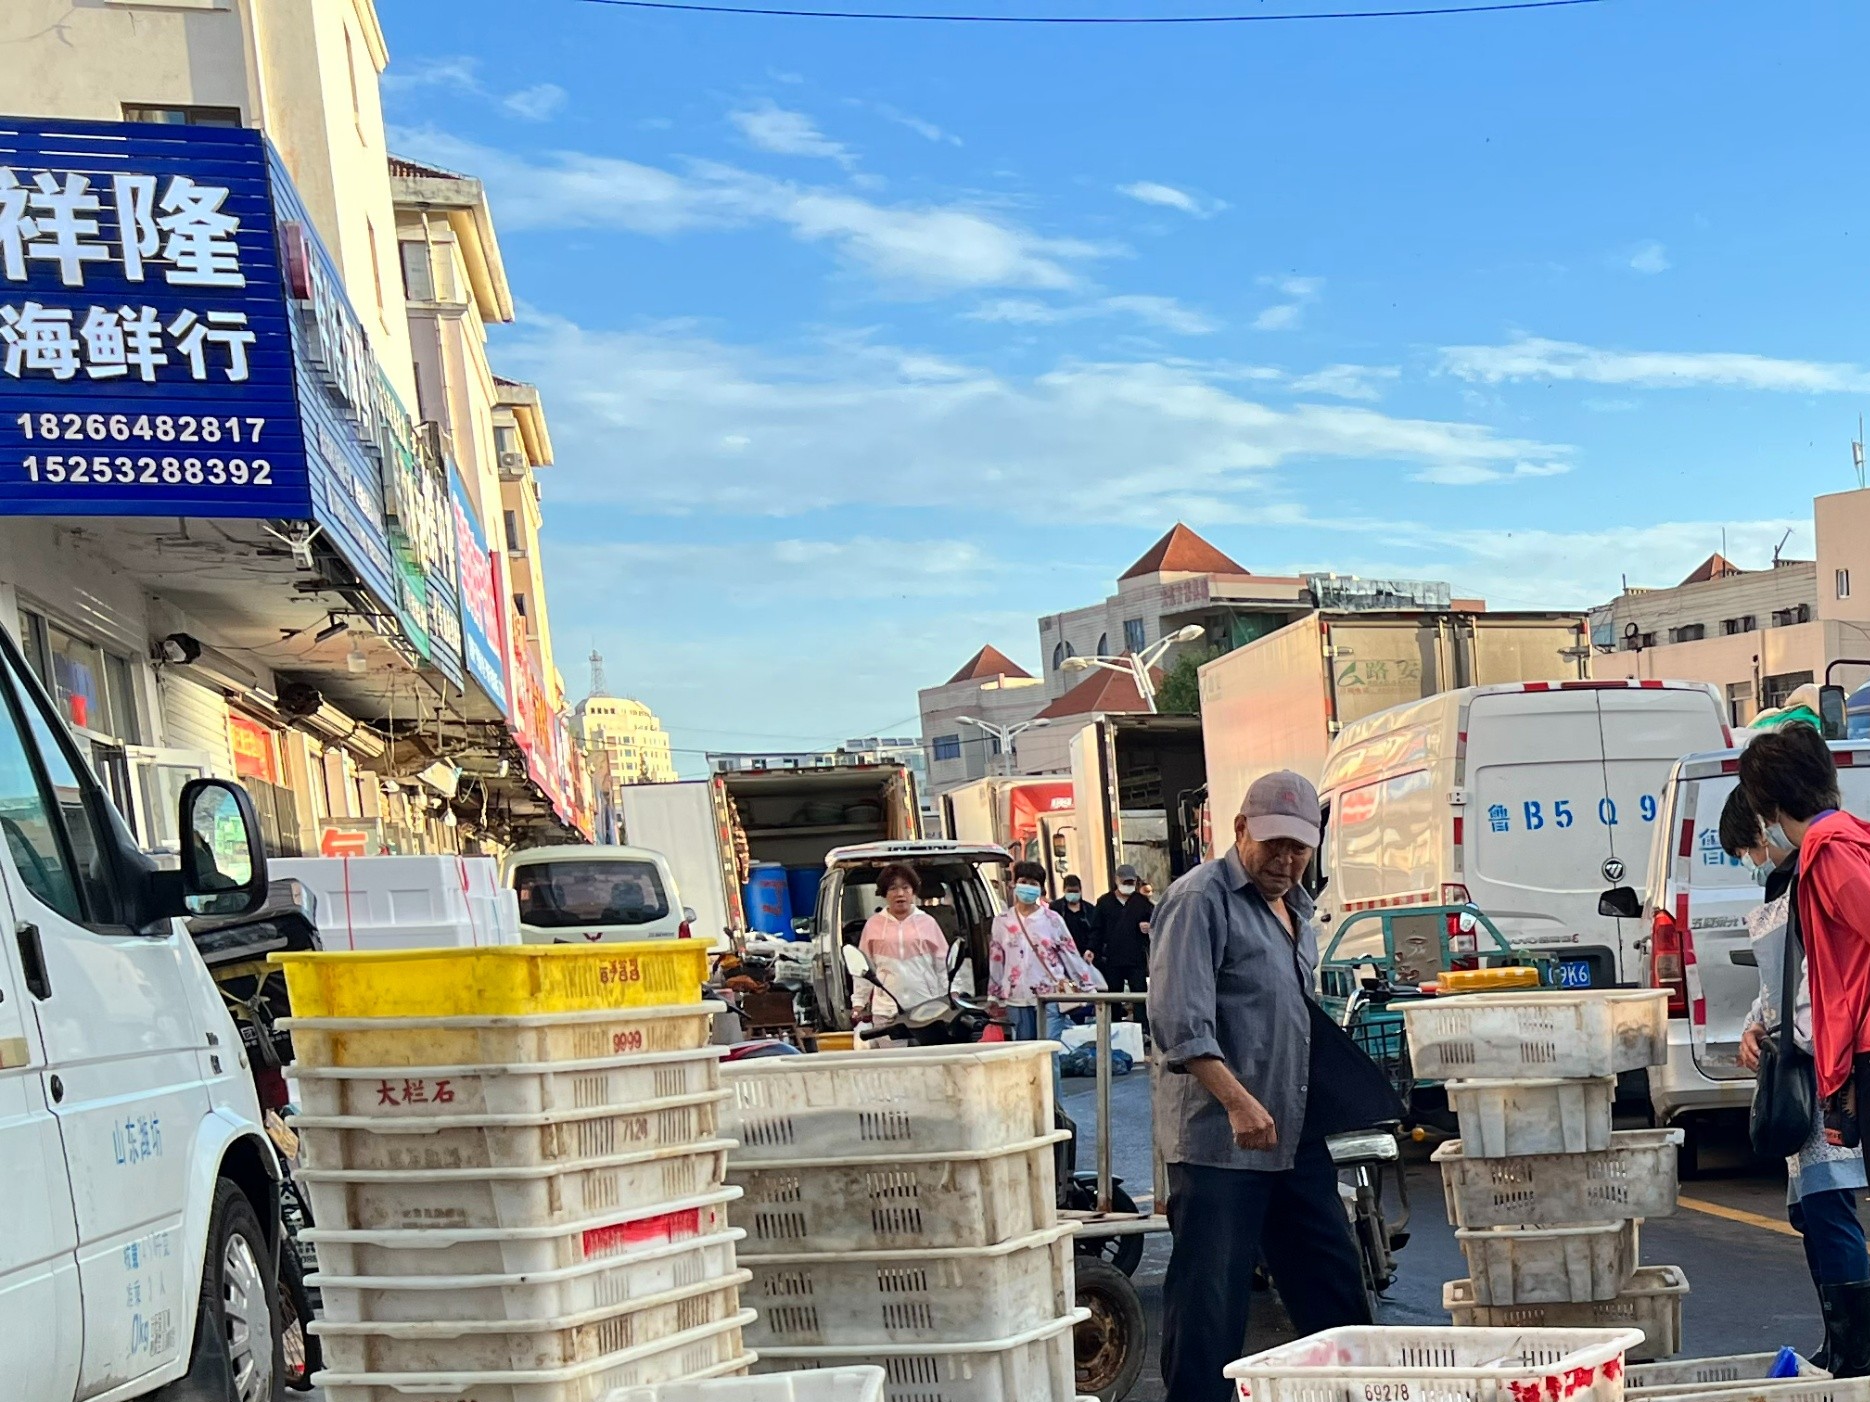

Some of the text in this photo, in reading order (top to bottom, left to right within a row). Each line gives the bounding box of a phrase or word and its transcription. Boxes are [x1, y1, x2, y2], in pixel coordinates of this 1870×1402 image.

[0, 166, 246, 288] 祥隆
[1, 301, 256, 382] 海鲜行
[17, 412, 266, 443] 18266482817
[22, 455, 273, 485] 15253288392
[376, 1079, 455, 1106] 大栏石
